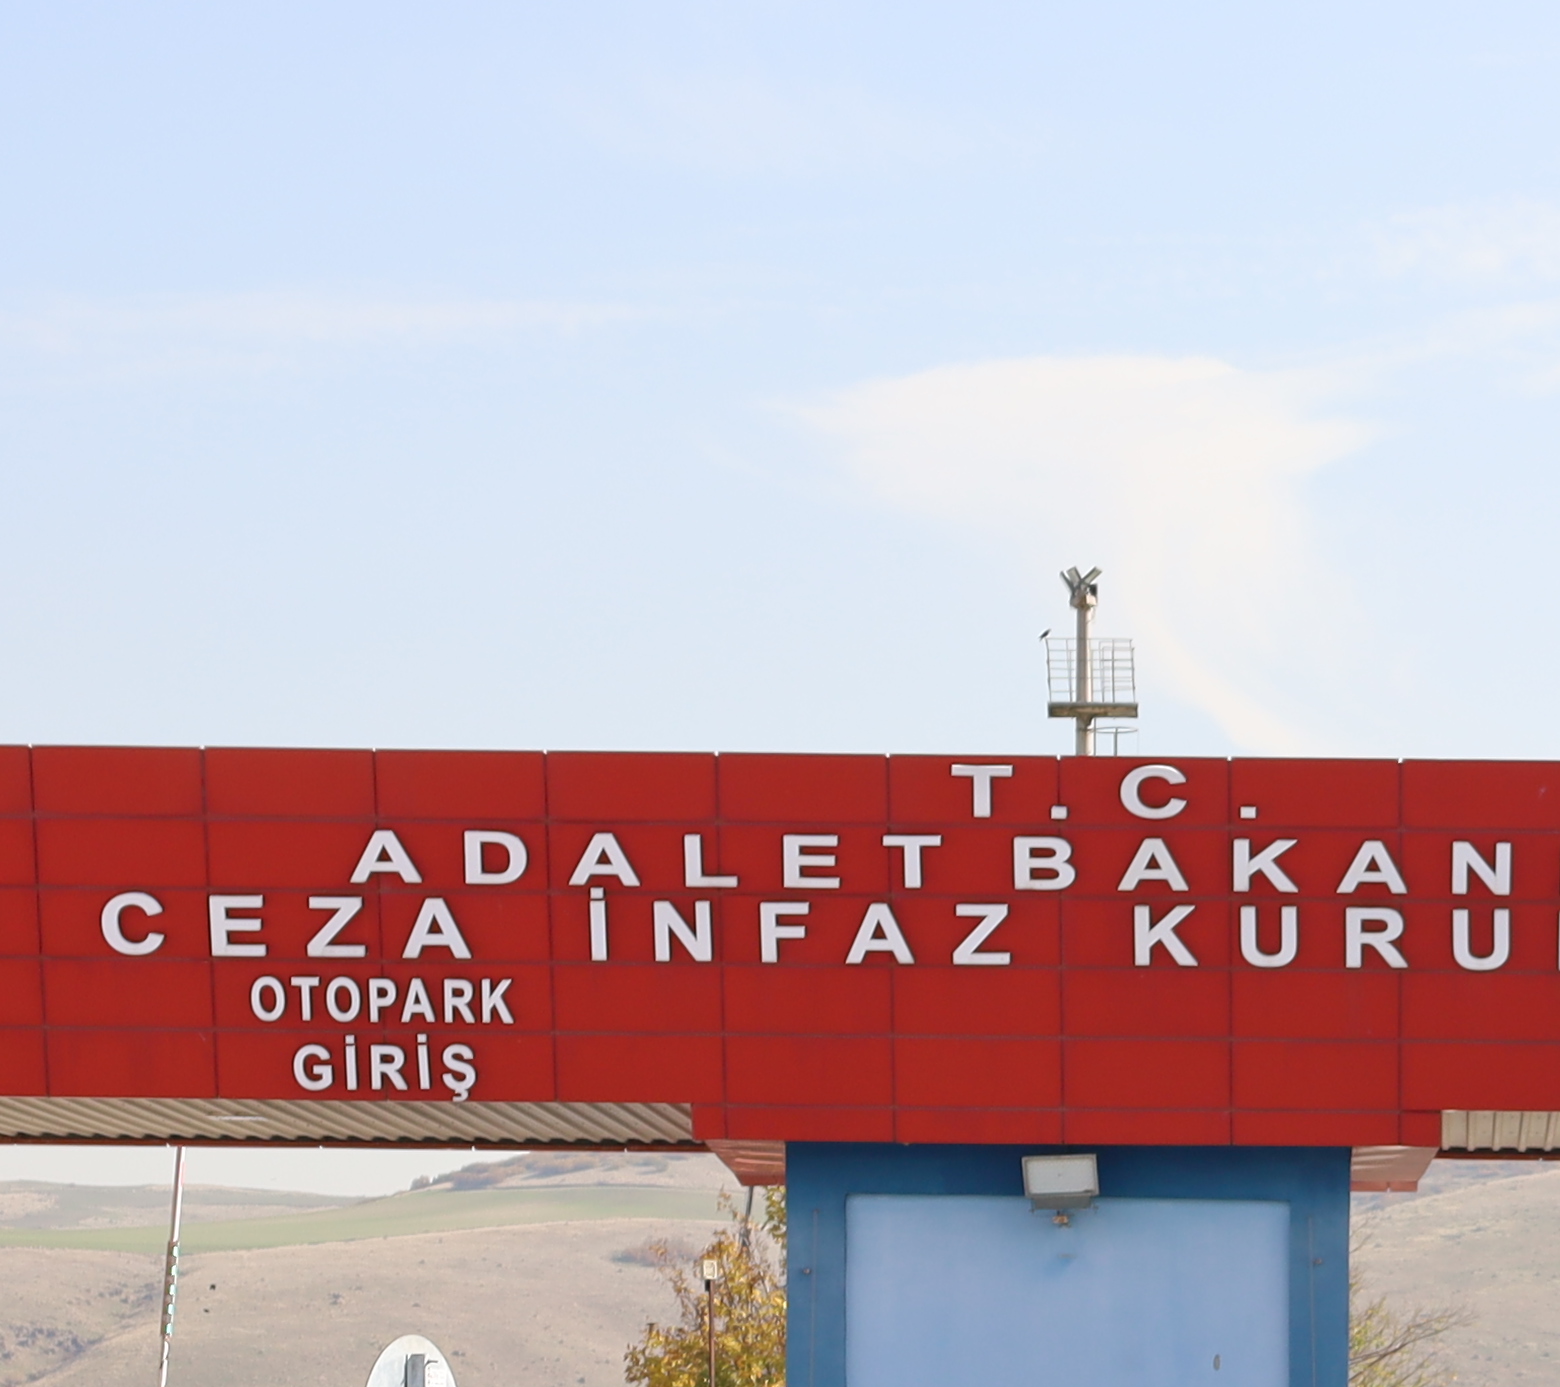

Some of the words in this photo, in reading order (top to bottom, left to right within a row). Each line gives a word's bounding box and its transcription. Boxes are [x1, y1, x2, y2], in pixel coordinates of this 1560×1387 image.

[951, 763, 1258, 821] T.C.
[350, 830, 942, 889] ADALET
[101, 892, 472, 959] CEZA
[589, 887, 1011, 965] İNFAZ
[250, 976, 514, 1024] OTOPARK
[293, 1033, 478, 1103] GİRİŞ
